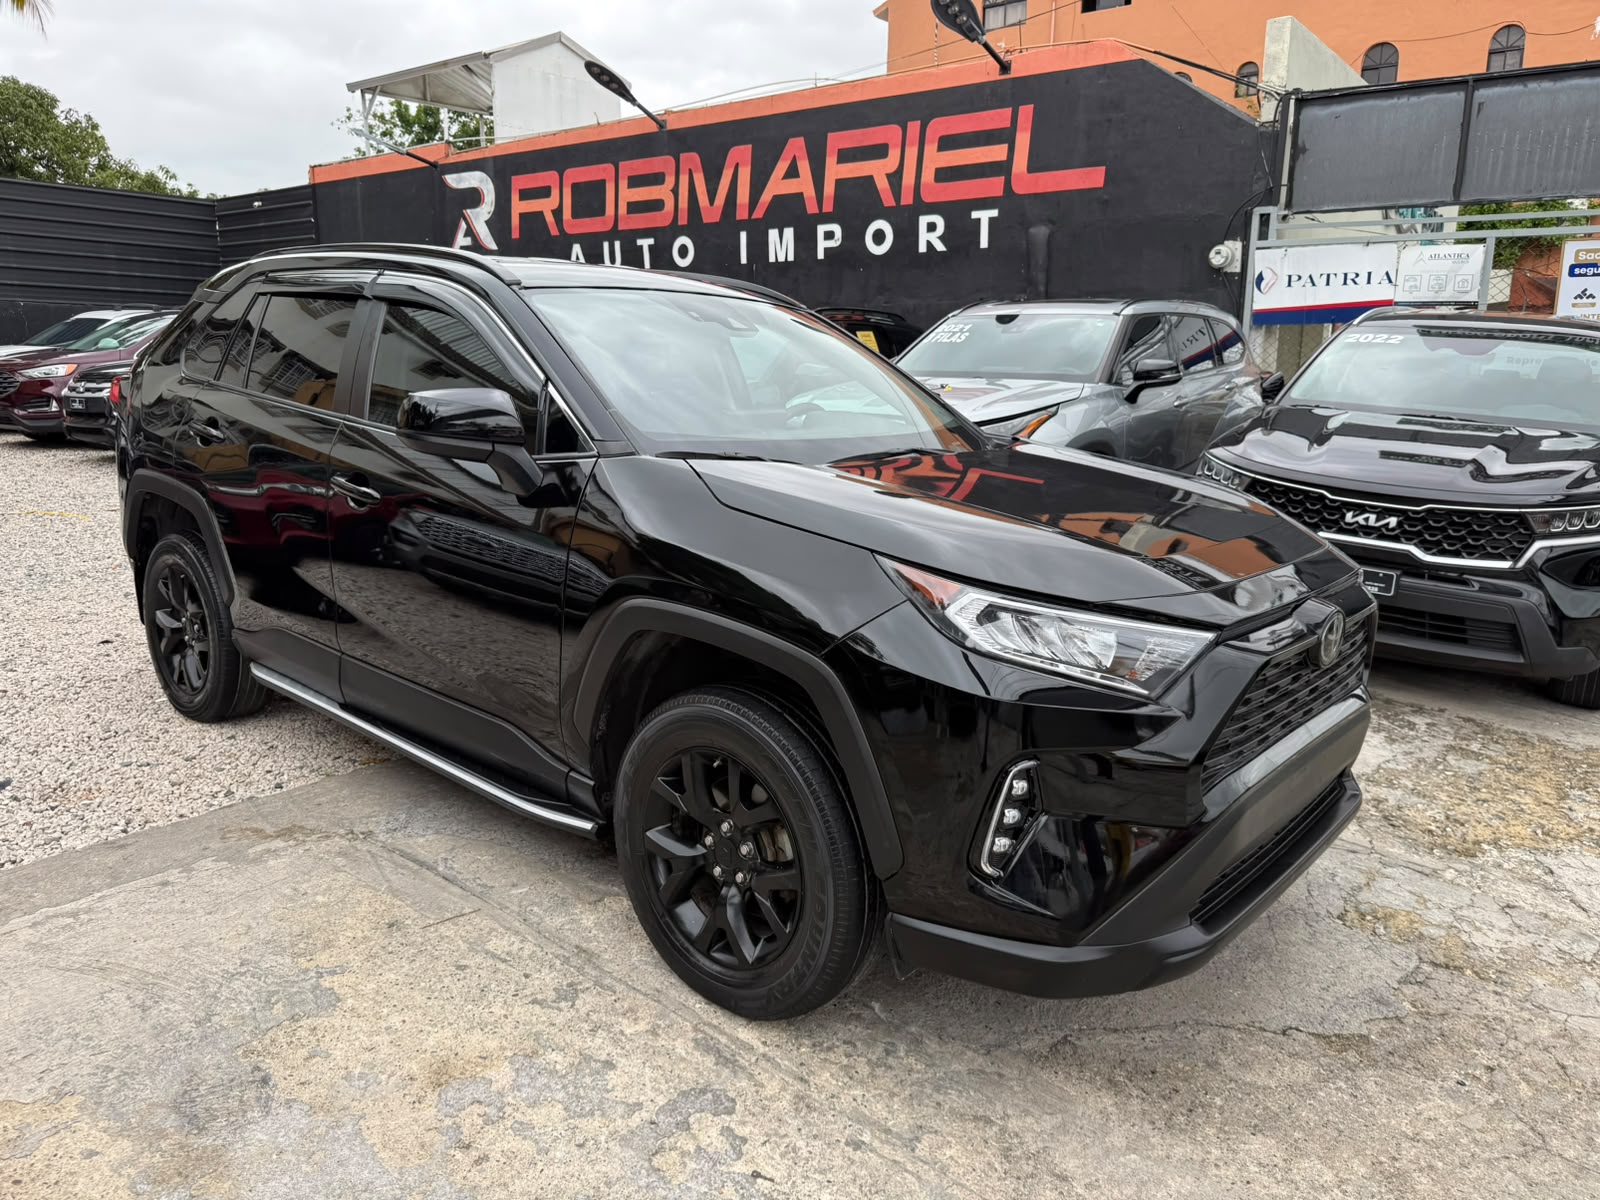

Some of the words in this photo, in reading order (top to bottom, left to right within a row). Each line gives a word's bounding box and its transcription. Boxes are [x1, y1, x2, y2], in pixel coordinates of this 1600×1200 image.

[511, 104, 1106, 239] ROBMARIEL
[570, 235, 695, 269] AUTO
[739, 209, 999, 264] IMPORT
[1428, 252, 1470, 260] ATLANTICA
[1286, 270, 1397, 287] PATRIA
[1344, 333, 1404, 344] 2022
